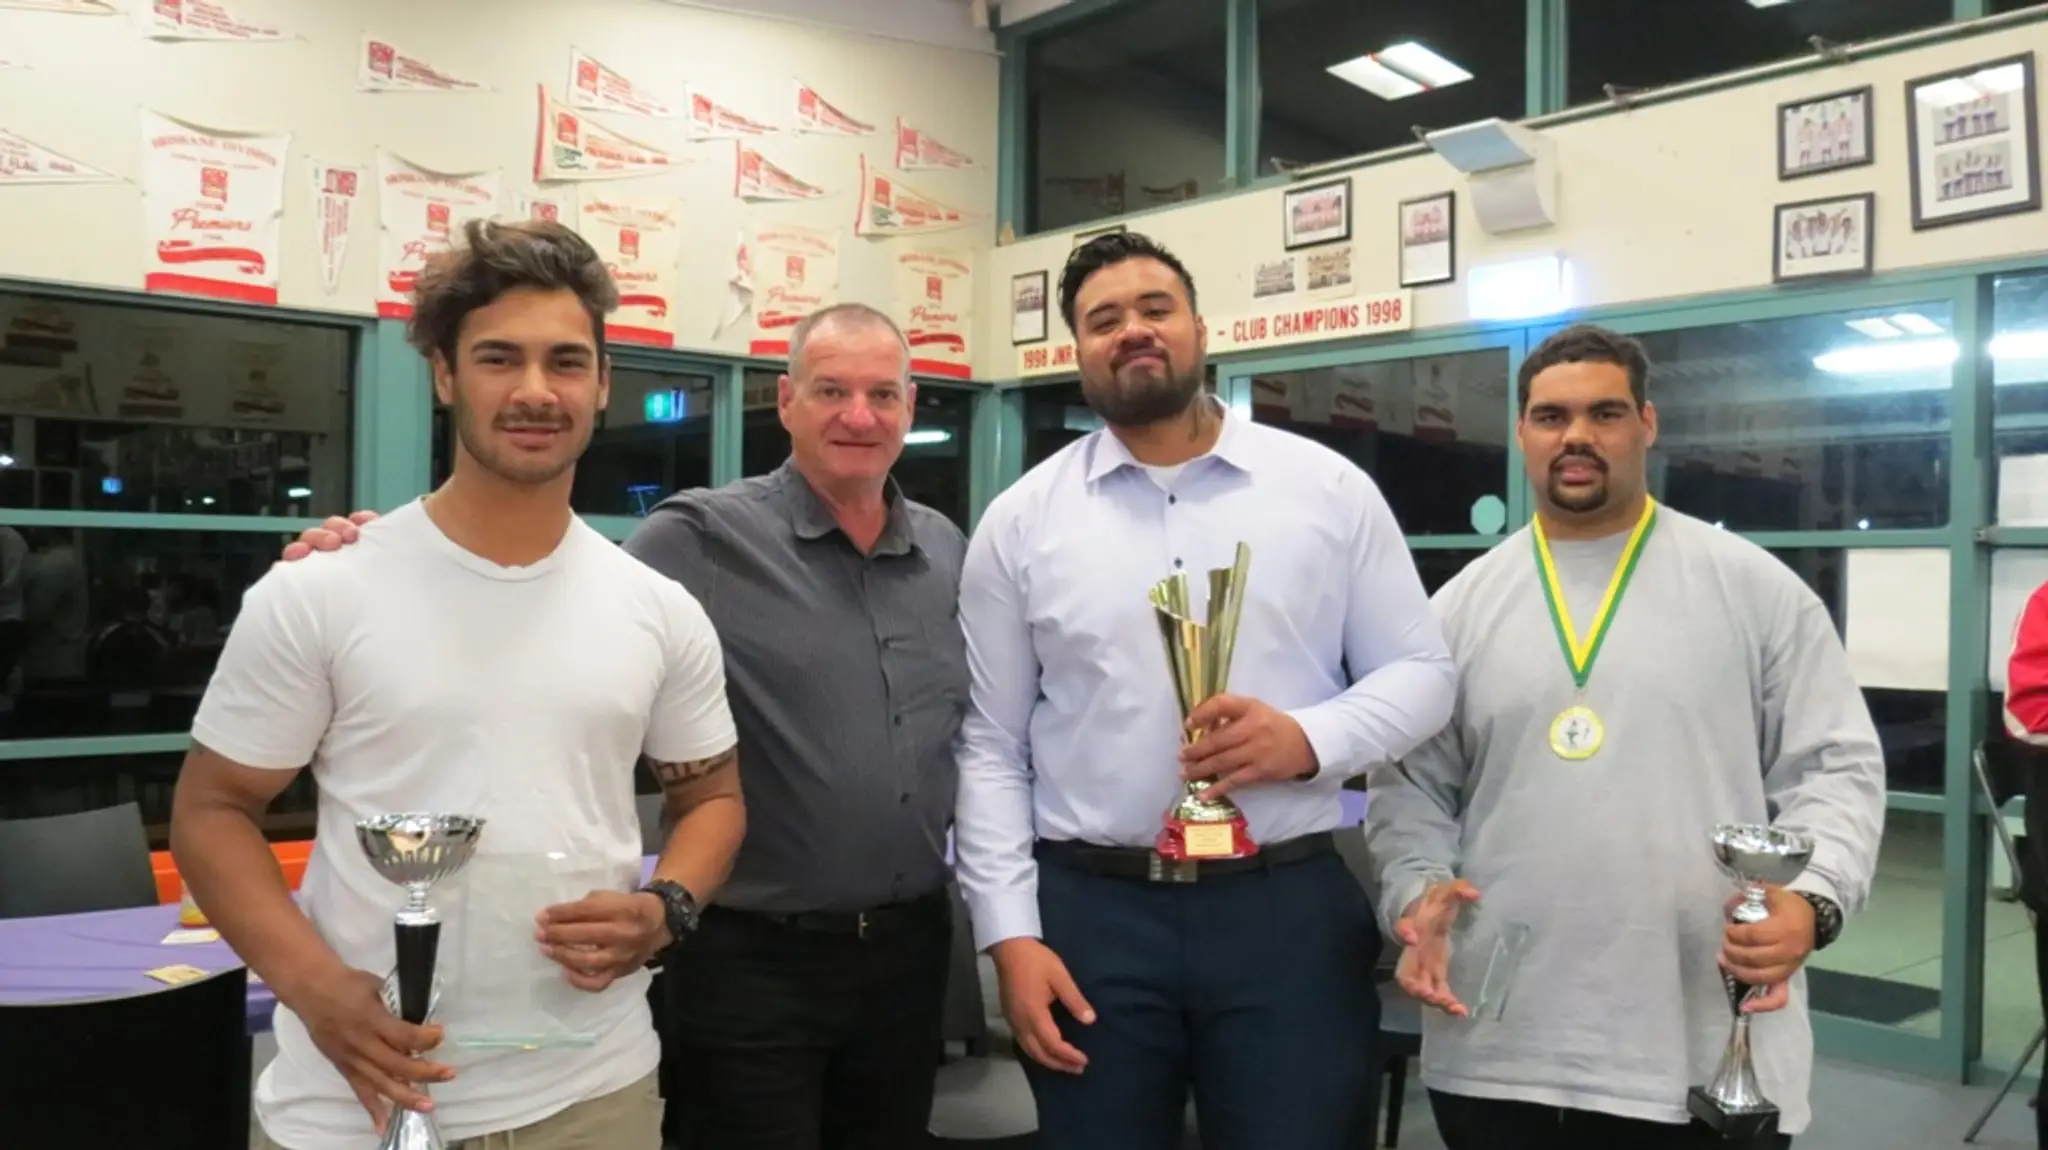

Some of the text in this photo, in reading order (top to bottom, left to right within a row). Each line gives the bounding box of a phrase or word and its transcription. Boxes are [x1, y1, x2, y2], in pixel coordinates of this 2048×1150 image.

[170, 207, 252, 231] Premiers
[1233, 317, 1267, 342] CLUB
[1274, 304, 1359, 336] CHAMPIONS
[1366, 298, 1403, 325] 1998
